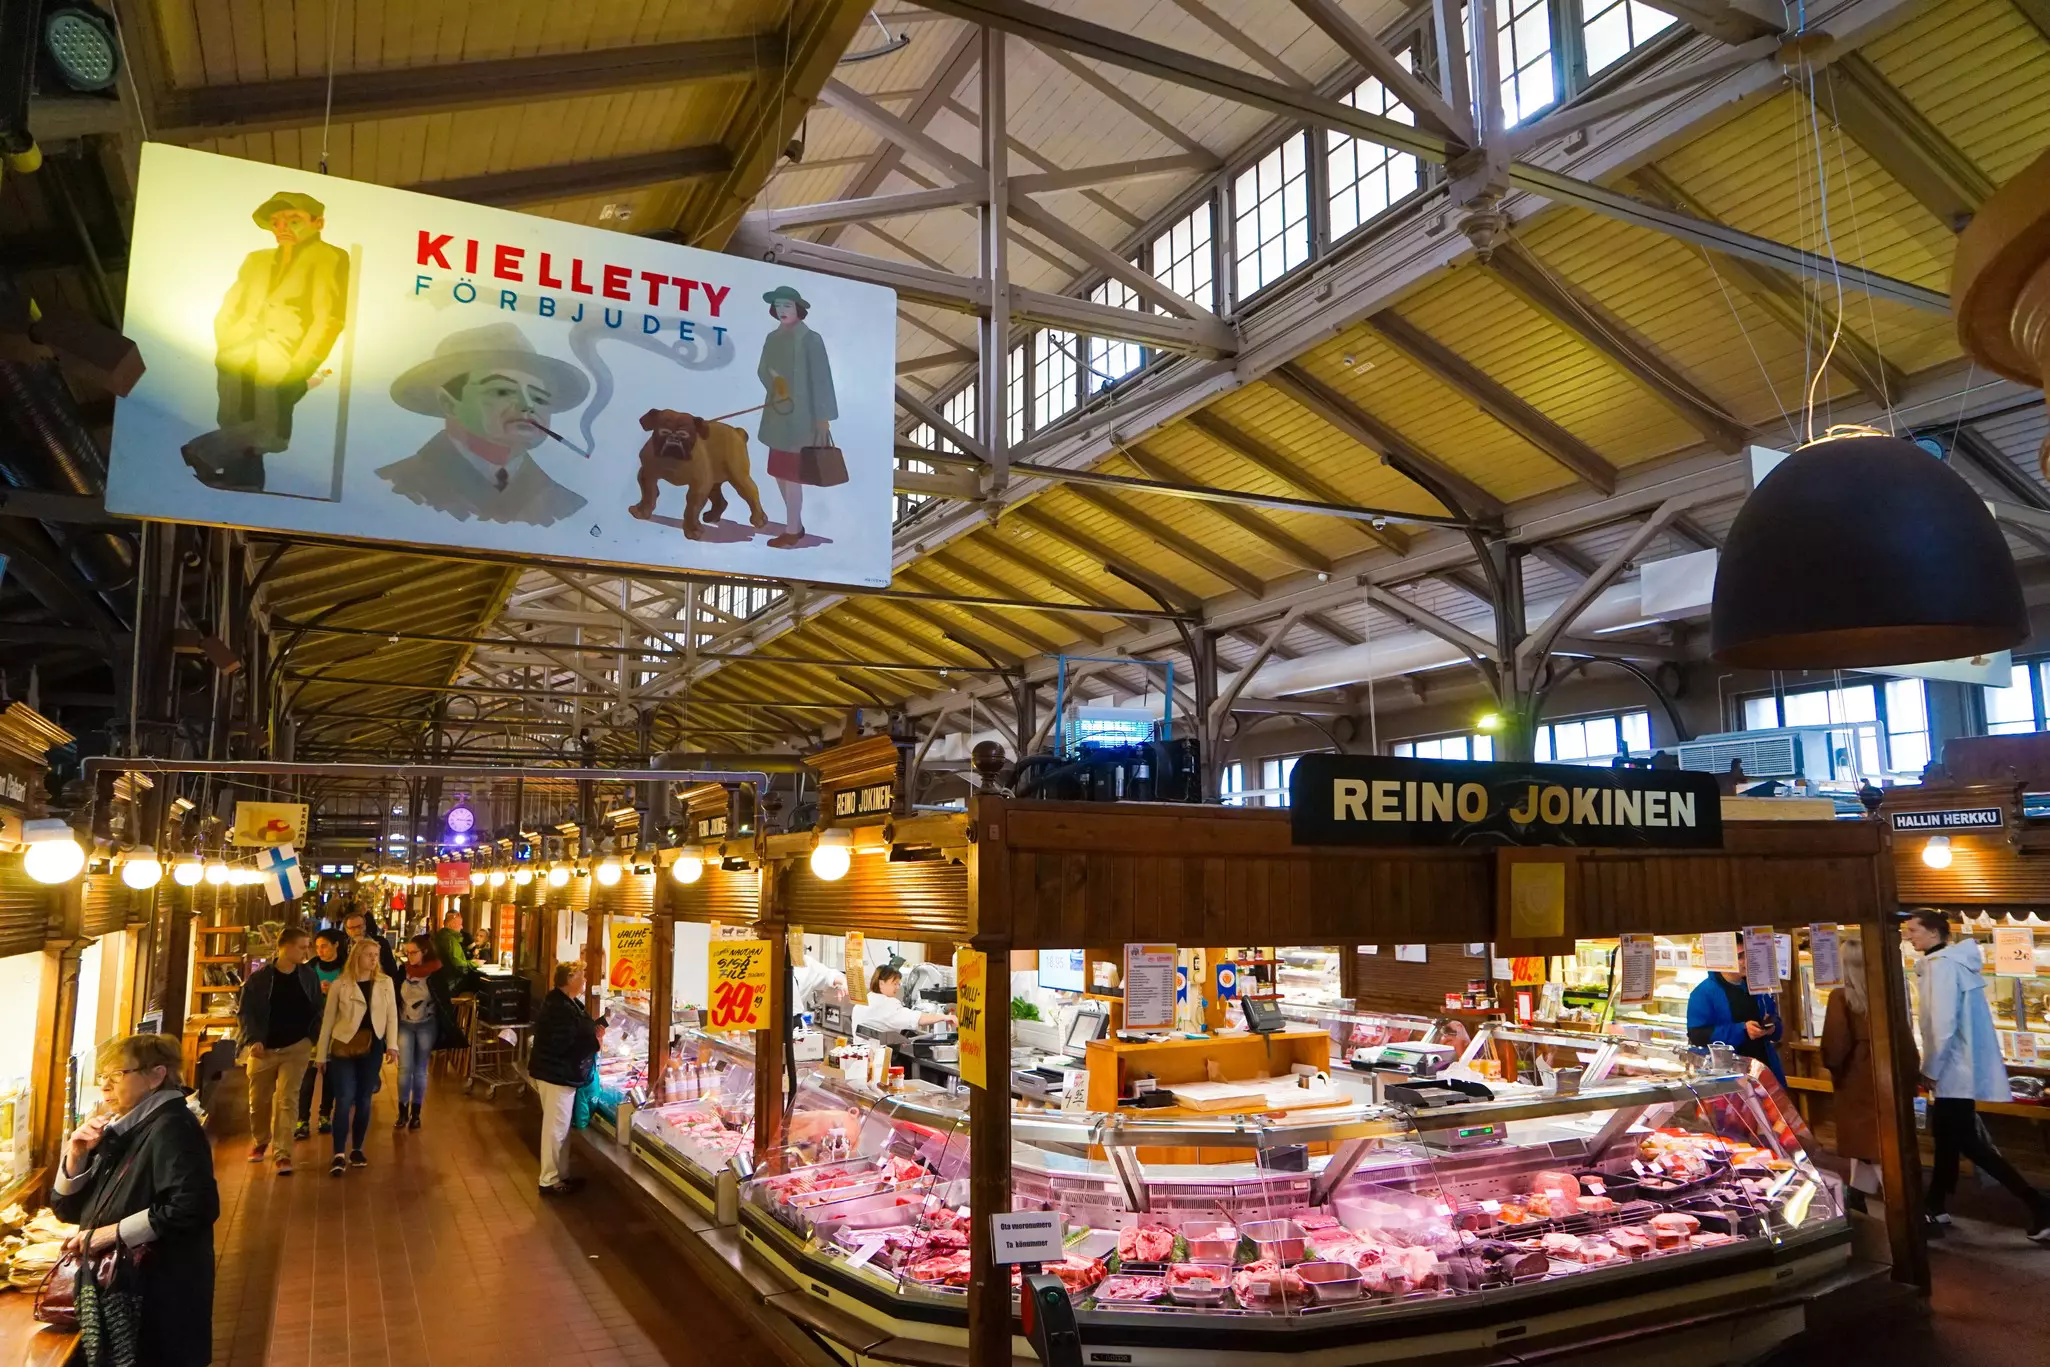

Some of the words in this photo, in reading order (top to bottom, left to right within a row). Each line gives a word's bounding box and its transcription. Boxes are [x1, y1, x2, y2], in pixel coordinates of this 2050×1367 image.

[417, 230, 731, 317] KIELLETTY
[415, 274, 728, 346] FÖRBJUDET
[836, 791, 856, 816] REINO
[858, 784, 891, 812] JOKINEN
[1333, 778, 1489, 823] REINO
[1509, 784, 1696, 828] JOKINEN
[1896, 814, 1941, 827] HALLIN
[1943, 811, 1997, 825] HERKKU
[617, 939, 644, 949] LIHA
[1000, 1223, 1011, 1231] Ota
[1012, 1221, 1052, 1230] vuoronumero
[1006, 1241, 1014, 1249] Ta
[1015, 1240, 1048, 1248] könummer
